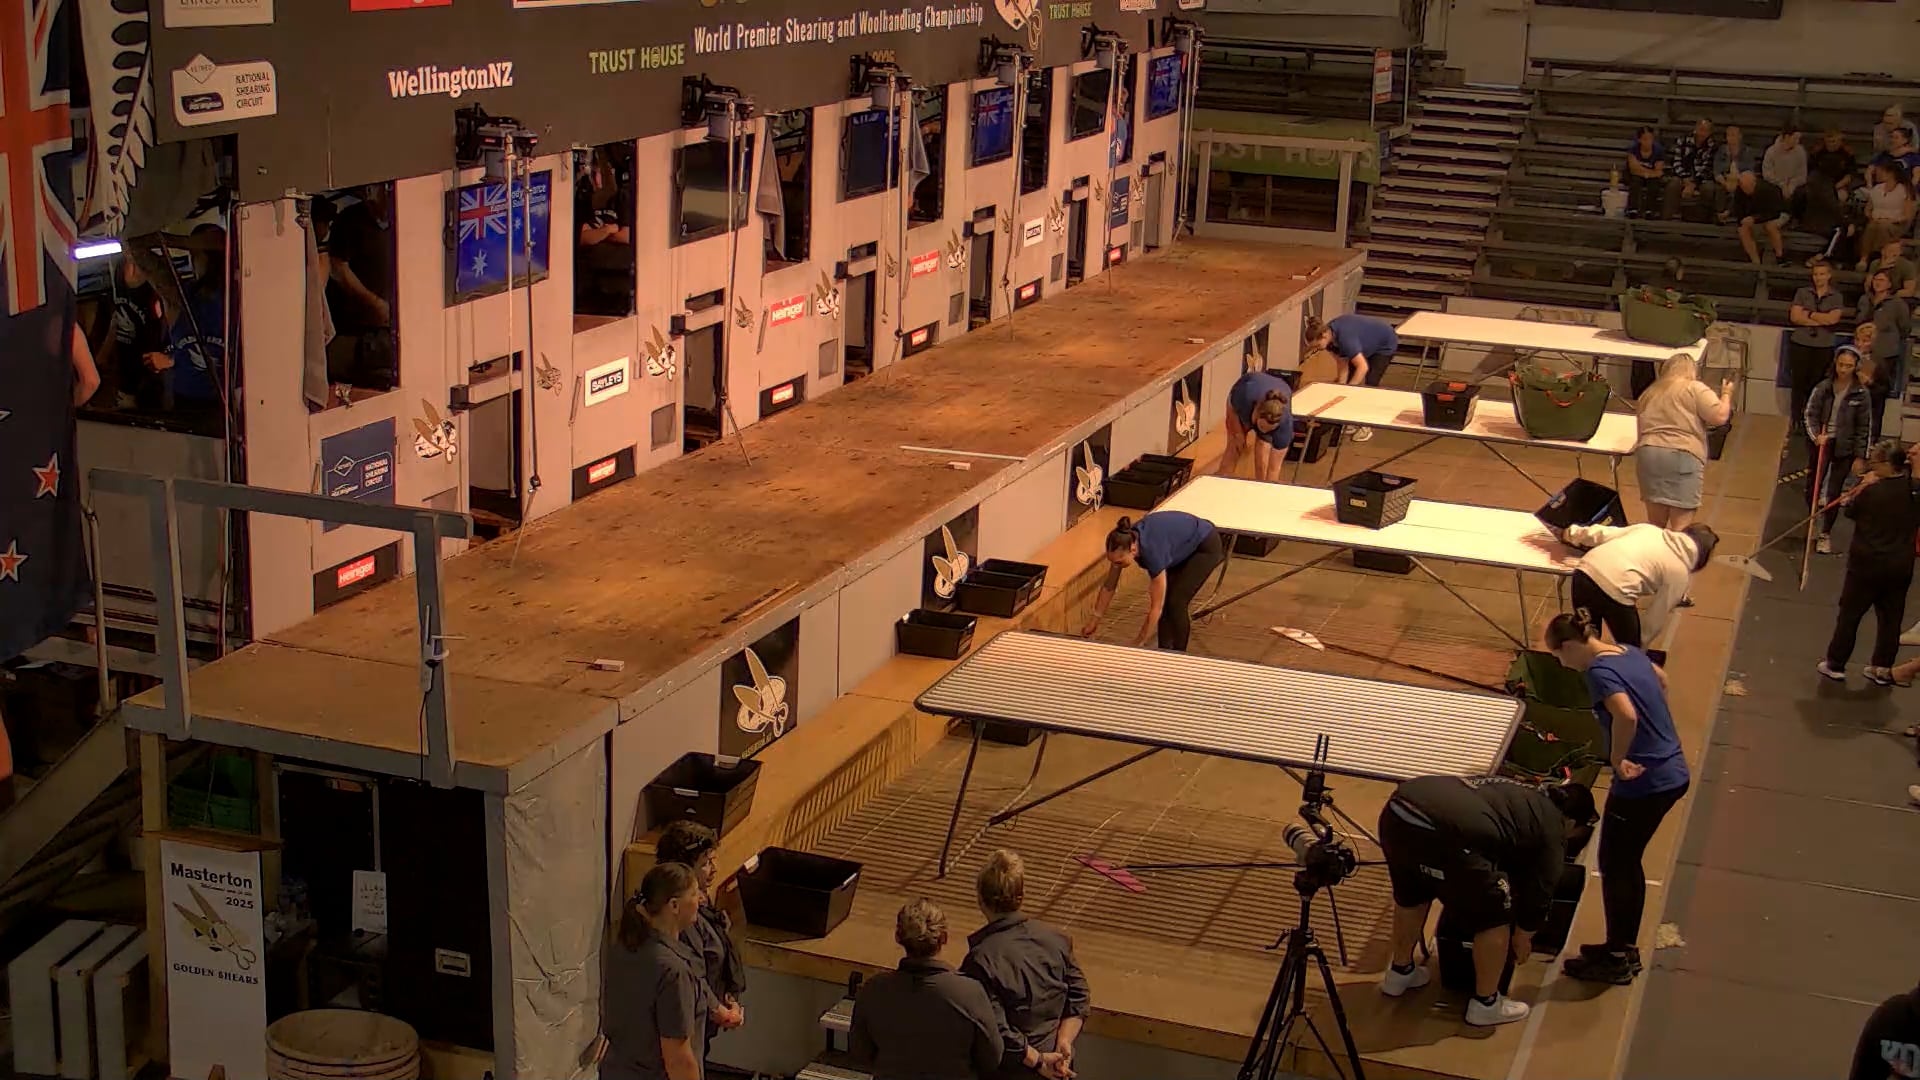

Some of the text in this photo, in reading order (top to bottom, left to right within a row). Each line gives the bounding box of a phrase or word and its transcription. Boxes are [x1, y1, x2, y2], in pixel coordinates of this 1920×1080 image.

[1050, 5, 1070, 20] TRUST
[694, 2, 983, 54] World Premier Shearing and Woolhandling Championship
[589, 43, 685, 74] TRUST HOUSE
[235, 71, 270, 84] NATIONAL
[388, 61, 513, 98] WellingtonNZ
[236, 83, 271, 96] SHEARING
[236, 96, 263, 109] CIRCUIT
[170, 862, 253, 889] Masterton
[226, 896, 254, 910] 2025
[173, 962, 259, 985] GOLDEN SHEARS
